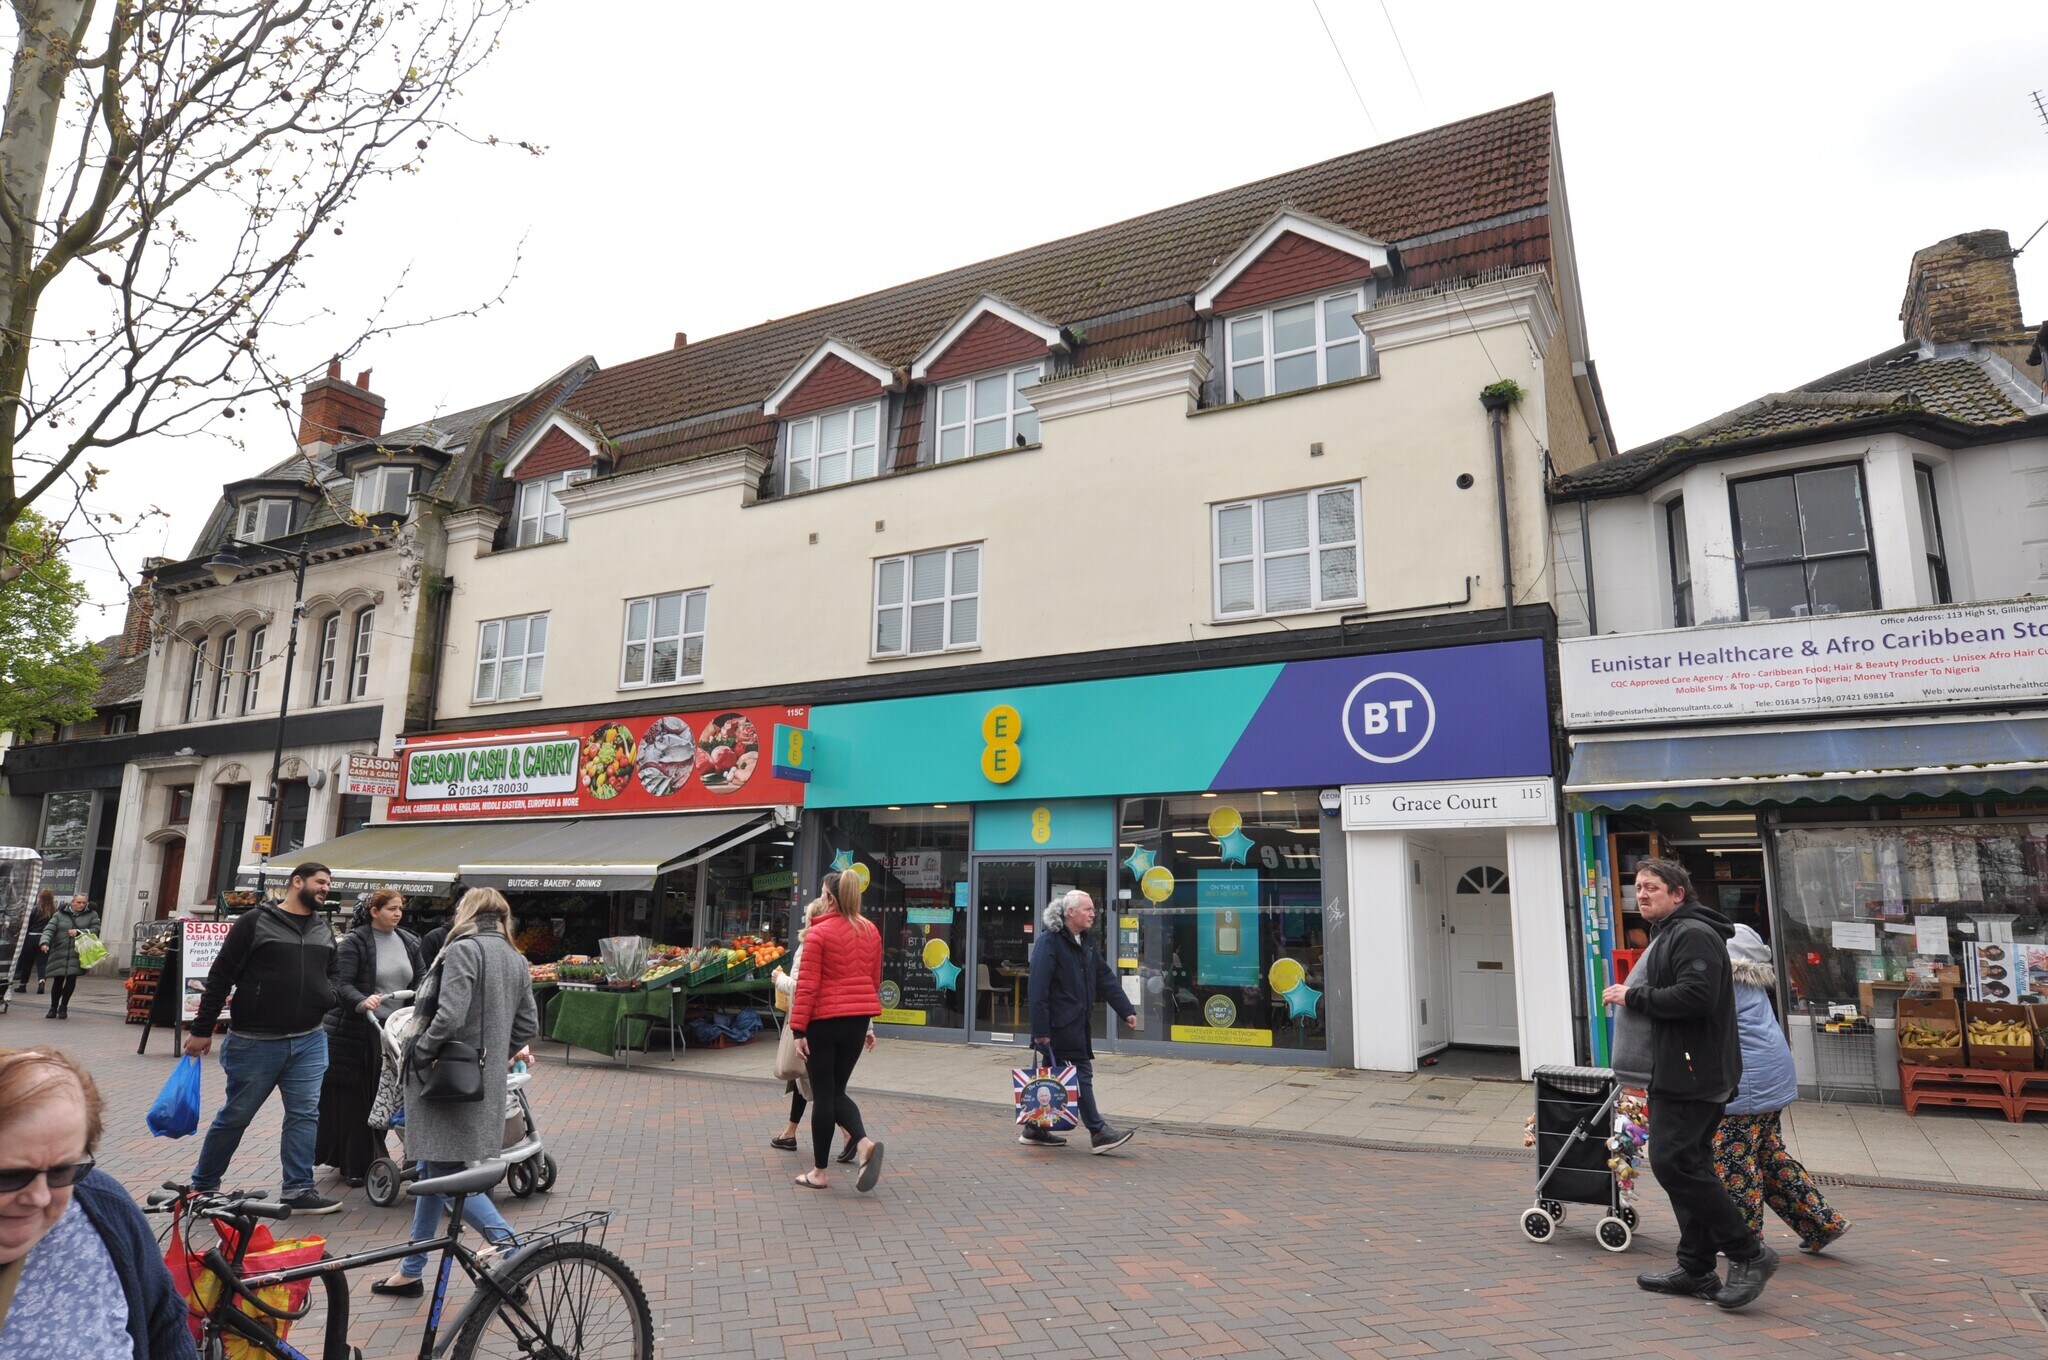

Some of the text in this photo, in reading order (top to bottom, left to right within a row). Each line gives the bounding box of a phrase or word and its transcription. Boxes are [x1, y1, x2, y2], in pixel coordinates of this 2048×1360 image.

[1907, 614, 1944, 623] Address:
[1965, 609, 1985, 618] High
[1987, 608, 1999, 616] St,
[1591, 655, 1672, 674] Eunistar
[1678, 646, 1793, 667] Healthcare
[1801, 640, 1819, 657] &
[1826, 636, 1875, 655] Afro
[1882, 627, 2005, 650] Caribbean
[1610, 680, 1628, 689] CQC
[1629, 677, 1670, 688] Approved
[1671, 675, 1691, 684] Care
[1693, 673, 1724, 683] Agency
[1731, 671, 1751, 680] Afro
[1757, 668, 1803, 678] Caribbean
[1805, 665, 1832, 674] Food;
[1833, 662, 1853, 671] Hair
[1855, 661, 1864, 670] &
[1865, 660, 1899, 669] Beauty
[1901, 656, 1944, 667] Products
[1953, 652, 1986, 662] Unisex
[1989, 650, 2011, 660] Afro
[2014, 648, 2035, 657] Hair
[1676, 665, 1980, 694] Mobile Sims & Top-up, Cargo To Nigeria; Money Transfer To Nigeria
[1755, 691, 1894, 707] Tele: 01634 575249, 07421 698164
[1922, 687, 1945, 696] Web:
[787, 708, 804, 717] 115C
[1363, 700, 1413, 735] BT
[1571, 702, 1734, 719] Email: info@eunistarhealthconsultants.co.uk
[351, 757, 399, 771] SEASON
[409, 742, 577, 786] SEASON CASH & CARRY
[349, 768, 367, 776] CASH
[350, 783, 395, 795] WE ARE OPEN
[459, 782, 529, 796] 01634 780030
[391, 805, 412, 815] AFRICAN,
[482, 800, 501, 810] MIDDLE
[502, 799, 527, 810] EASTERN,
[527, 798, 556, 808] EUROPEAN
[556, 797, 561, 807] &
[562, 797, 580, 807] MORE
[1353, 788, 1542, 812] 115 Grace Court 115
[348, 882, 364, 890] FRUIT
[363, 882, 368, 890] &
[384, 883, 402, 892] DAIRY
[402, 884, 434, 893] PRODUCTS
[507, 878, 539, 887] BUTCHER
[543, 879, 571, 888] BAKERY
[575, 879, 602, 888] DRINKS
[193, 940, 213, 948] Fresh
